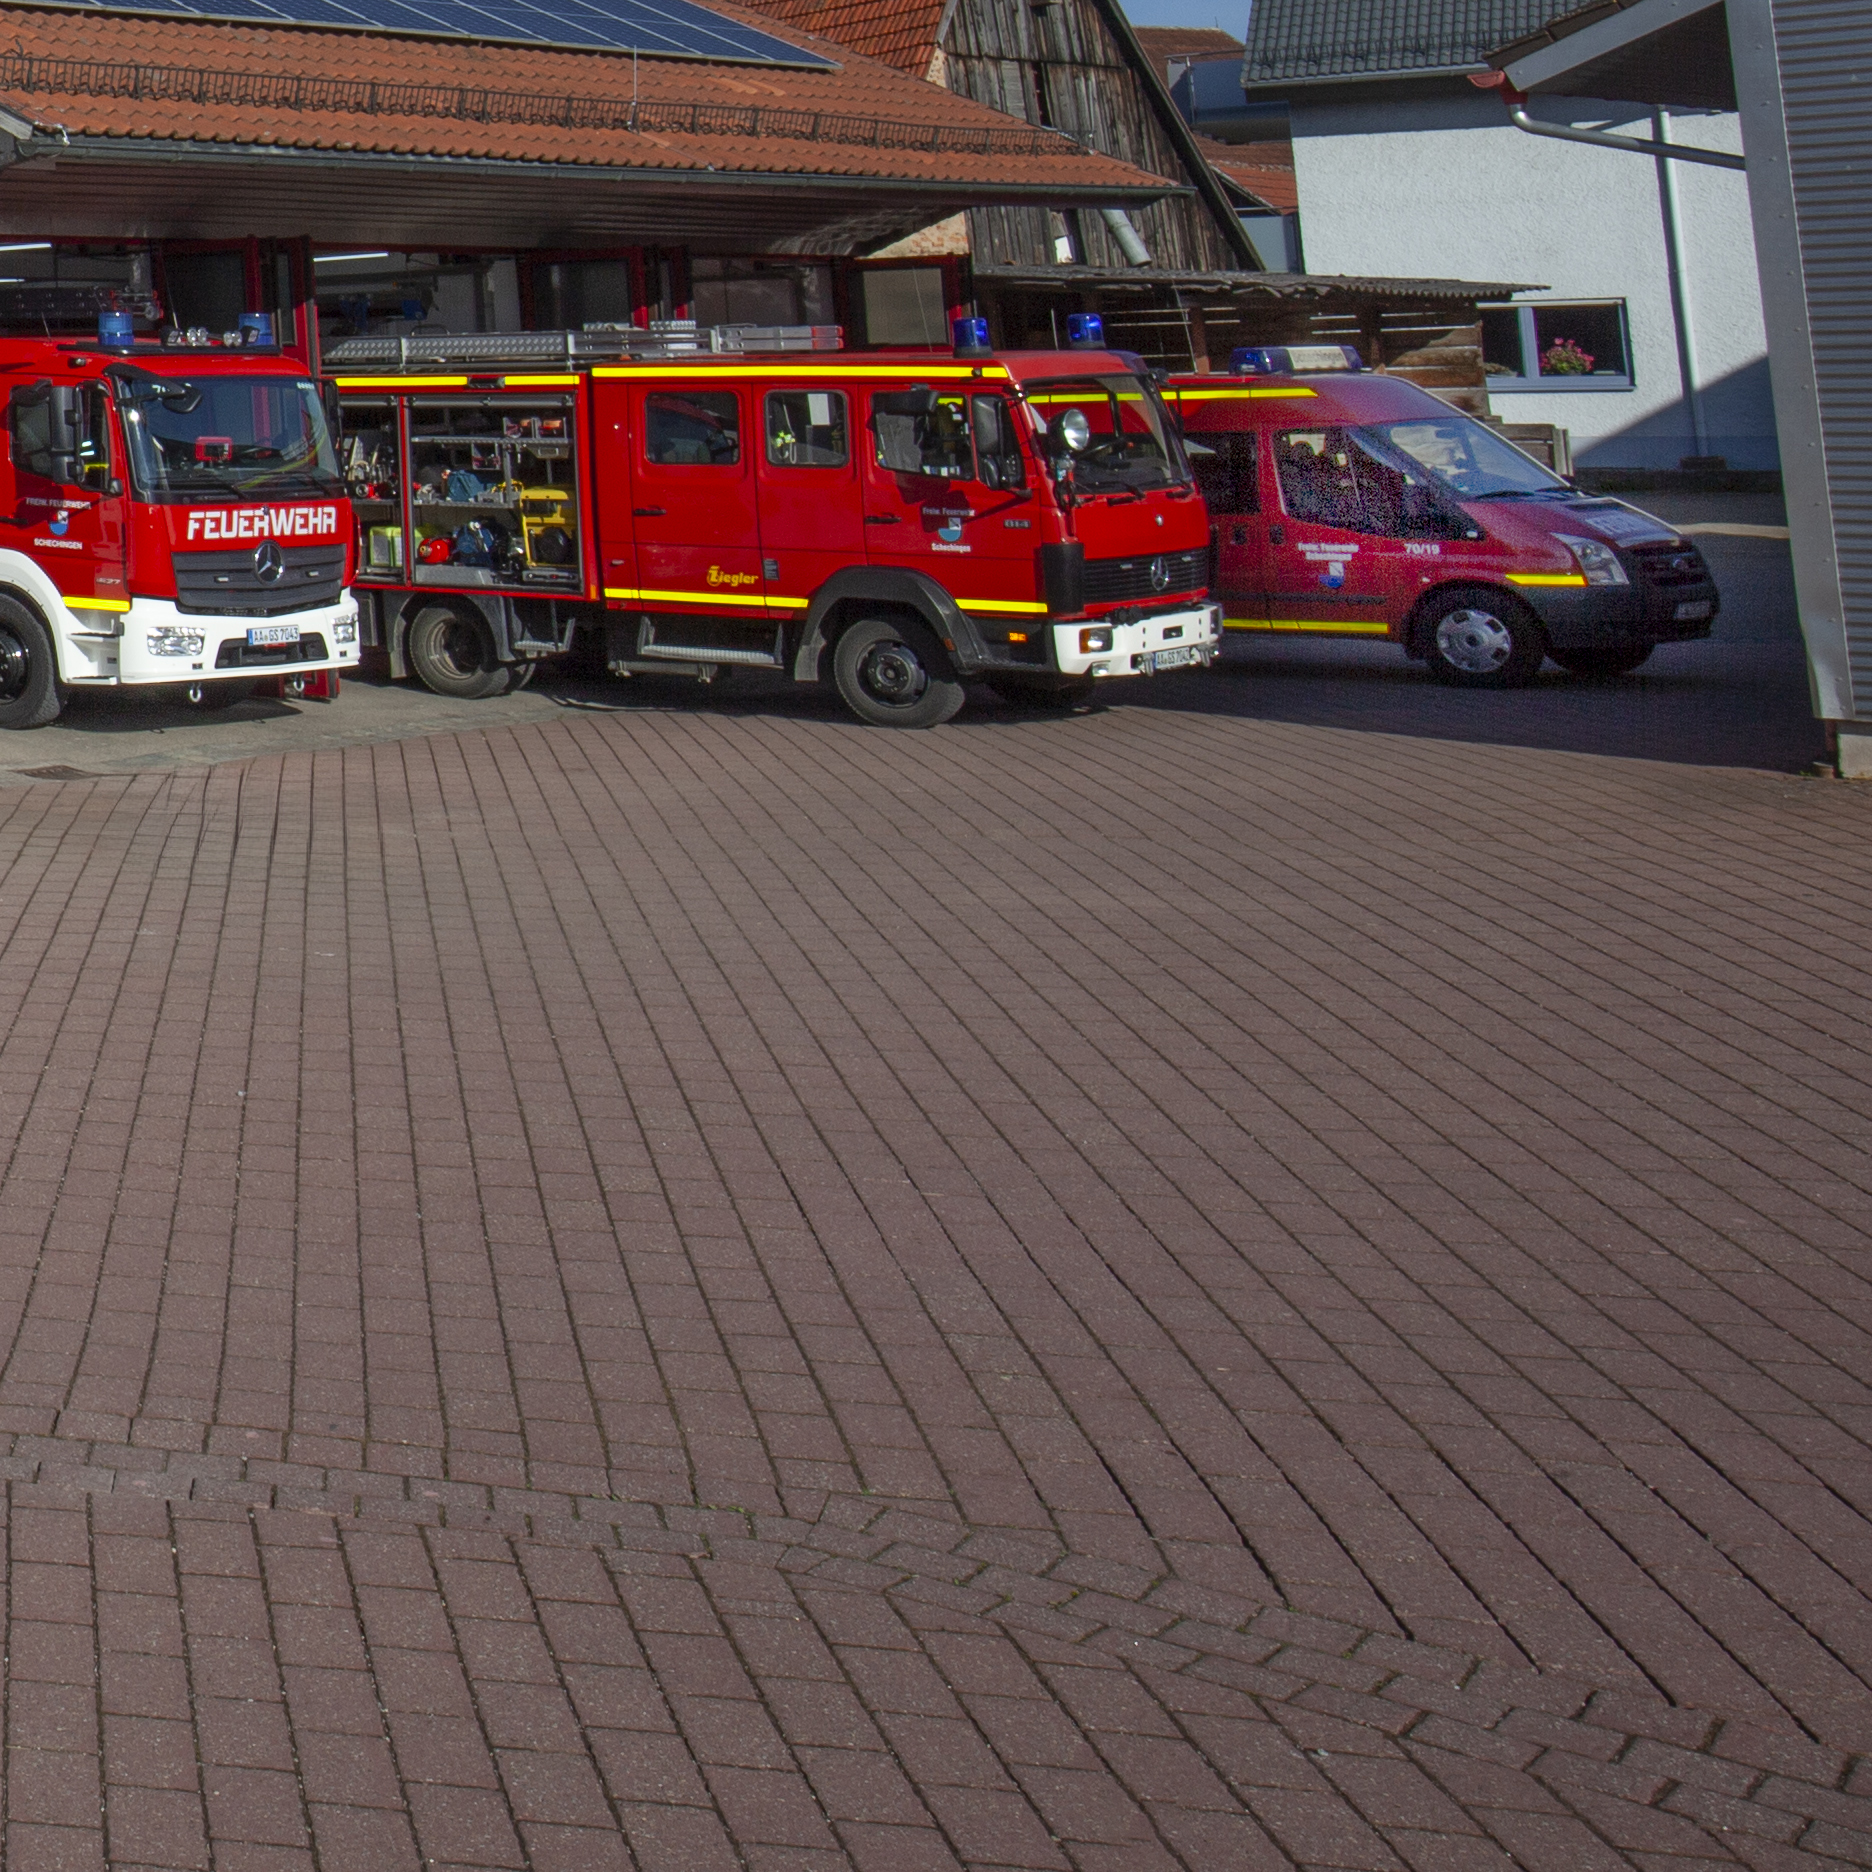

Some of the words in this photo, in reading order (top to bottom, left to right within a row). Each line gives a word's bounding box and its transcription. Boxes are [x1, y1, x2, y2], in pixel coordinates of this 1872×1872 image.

[49, 498, 92, 510] FEUERWEHR
[187, 506, 336, 540] FEUERWEHR
[34, 537, 83, 550] SCHECHINGEN
[931, 542, 971, 554] Schechingen
[1404, 543, 1440, 555] 70/19
[706, 565, 759, 587] Ziegler
